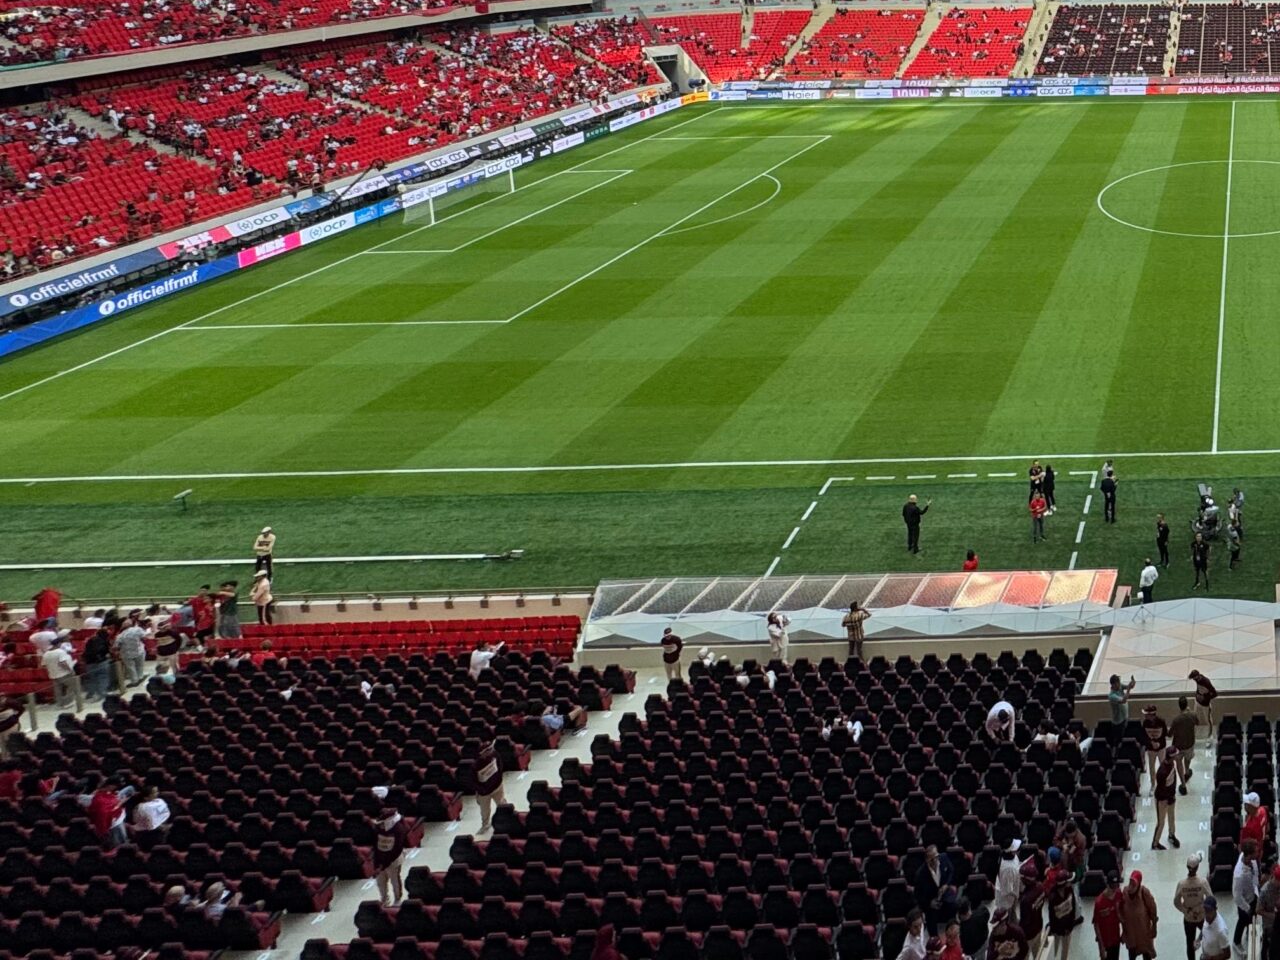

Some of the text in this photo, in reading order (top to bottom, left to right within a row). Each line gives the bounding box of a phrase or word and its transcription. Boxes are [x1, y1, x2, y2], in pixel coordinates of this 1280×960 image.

[788, 90, 815, 99] Haier
[429, 152, 466, 167] CDG CDG
[488, 165, 502, 174] CDG
[252, 212, 279, 226] OCP
[324, 219, 346, 233] OCP
[30, 264, 120, 302] officielfrmf
[117, 270, 199, 309] officielfrmf
[1201, 796, 1210, 804] M
[1138, 824, 1147, 832] N
[1199, 822, 1208, 830] N
